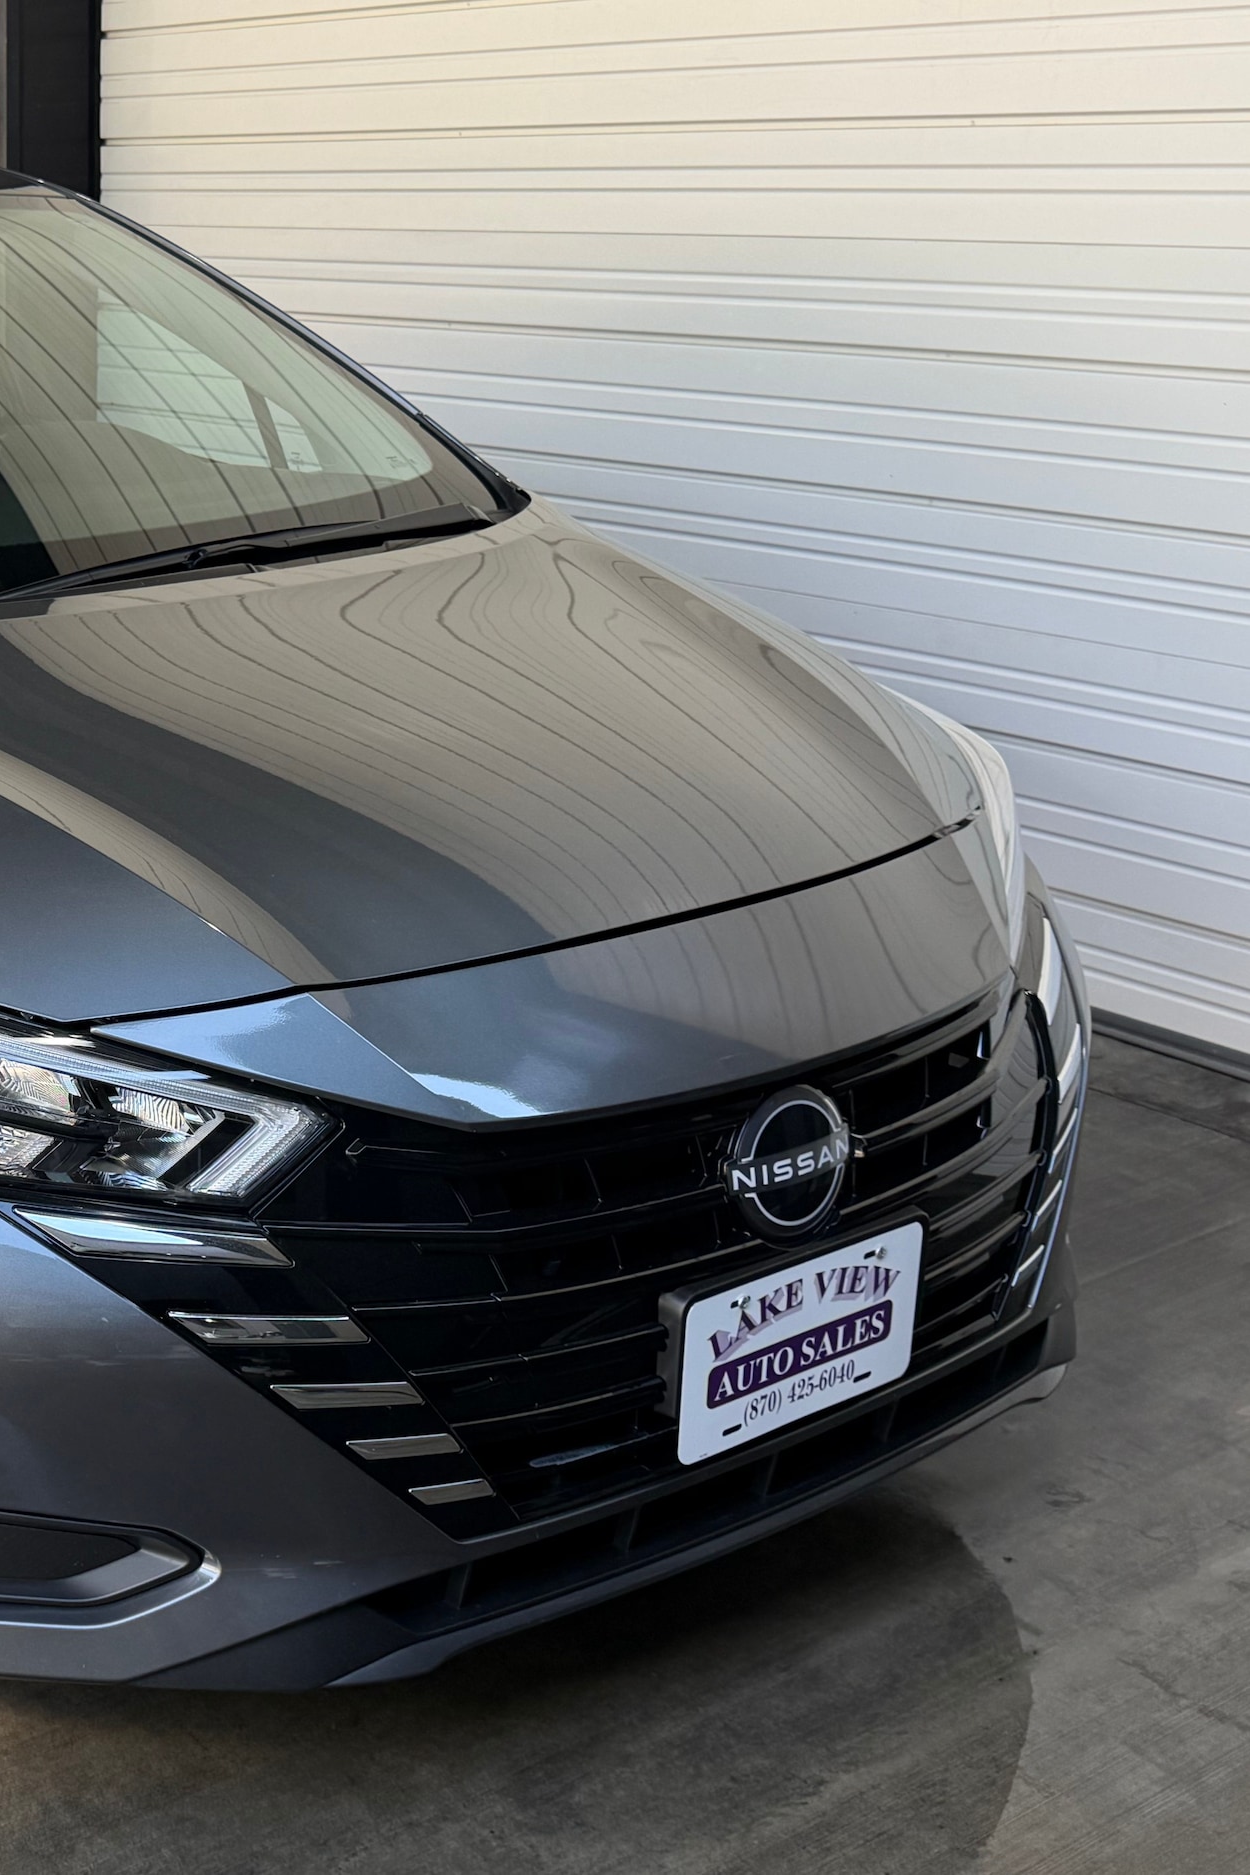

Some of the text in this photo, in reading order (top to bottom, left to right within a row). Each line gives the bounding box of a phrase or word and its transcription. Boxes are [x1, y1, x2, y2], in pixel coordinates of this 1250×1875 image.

[732, 1137, 849, 1191] NISSAN
[707, 1264, 901, 1361] LAKE VIEW
[713, 1309, 886, 1401] AUTO SALES
[743, 1358, 856, 1427] (870) 425-6040
